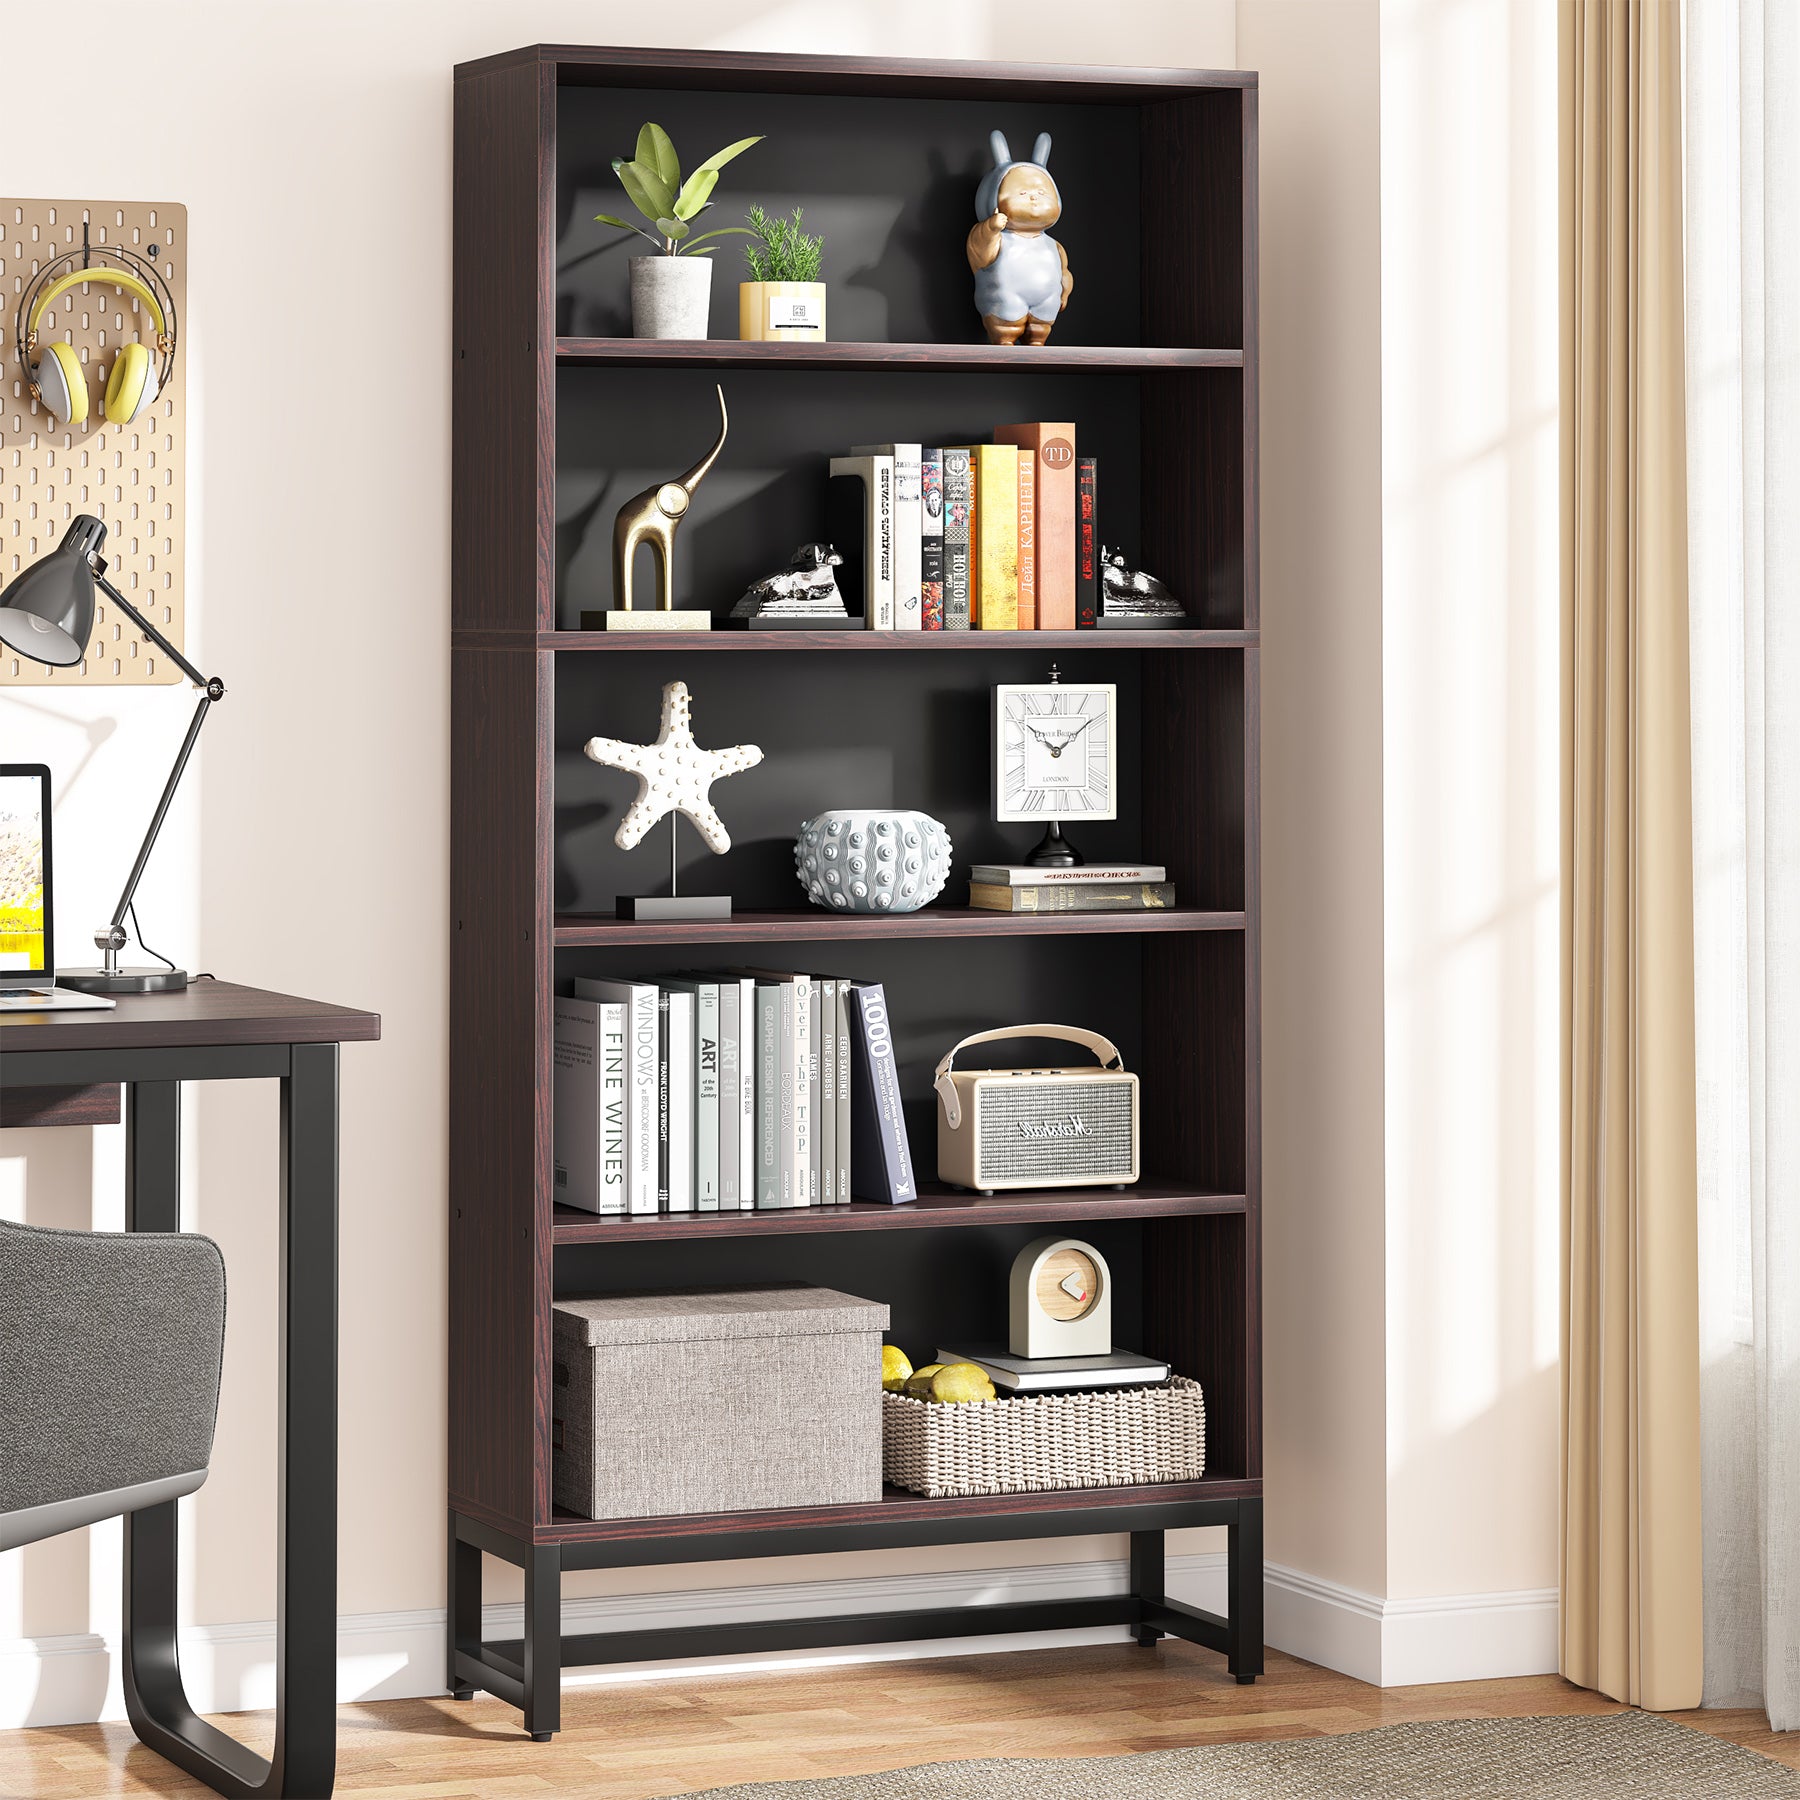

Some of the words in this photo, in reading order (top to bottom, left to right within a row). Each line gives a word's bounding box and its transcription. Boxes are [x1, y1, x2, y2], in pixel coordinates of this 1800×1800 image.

[1045, 447, 1071, 462] TD
[1020, 460, 1033, 549] КАРНЕГИ
[1021, 556, 1035, 595] Дейл
[764, 1005, 774, 1052] GRAPHIC
[797, 984, 807, 1038] Over
[862, 992, 891, 1058] 1000
[637, 993, 654, 1086] WINDOWS
[701, 1038, 716, 1073] ART
[722, 1037, 737, 1073] ART
[824, 1033, 832, 1055] ARNE
[839, 1036, 847, 1057] EERO
[605, 1033, 623, 1089] FINE
[660, 1061, 668, 1086] FRANK
[744, 1075, 752, 1085] THE
[764, 1055, 774, 1094] DESIGN
[797, 1054, 807, 1093] the
[809, 1053, 818, 1081] EAMES
[824, 1057, 832, 1099] JACOBSEN
[839, 1059, 847, 1100] SAARINEN
[660, 1086, 668, 1111] LLOYD
[744, 1087, 752, 1099] BIKE
[744, 1101, 752, 1115] BOOK
[781, 1072, 792, 1131] BORDEAUX
[641, 1095, 649, 1133] BERGDORF
[660, 1111, 668, 1142] WRIGHT
[764, 1097, 774, 1166] REFERENCED
[797, 1106, 807, 1151] Top
[605, 1100, 623, 1186] WINES
[641, 1133, 649, 1171] GOODMAN
